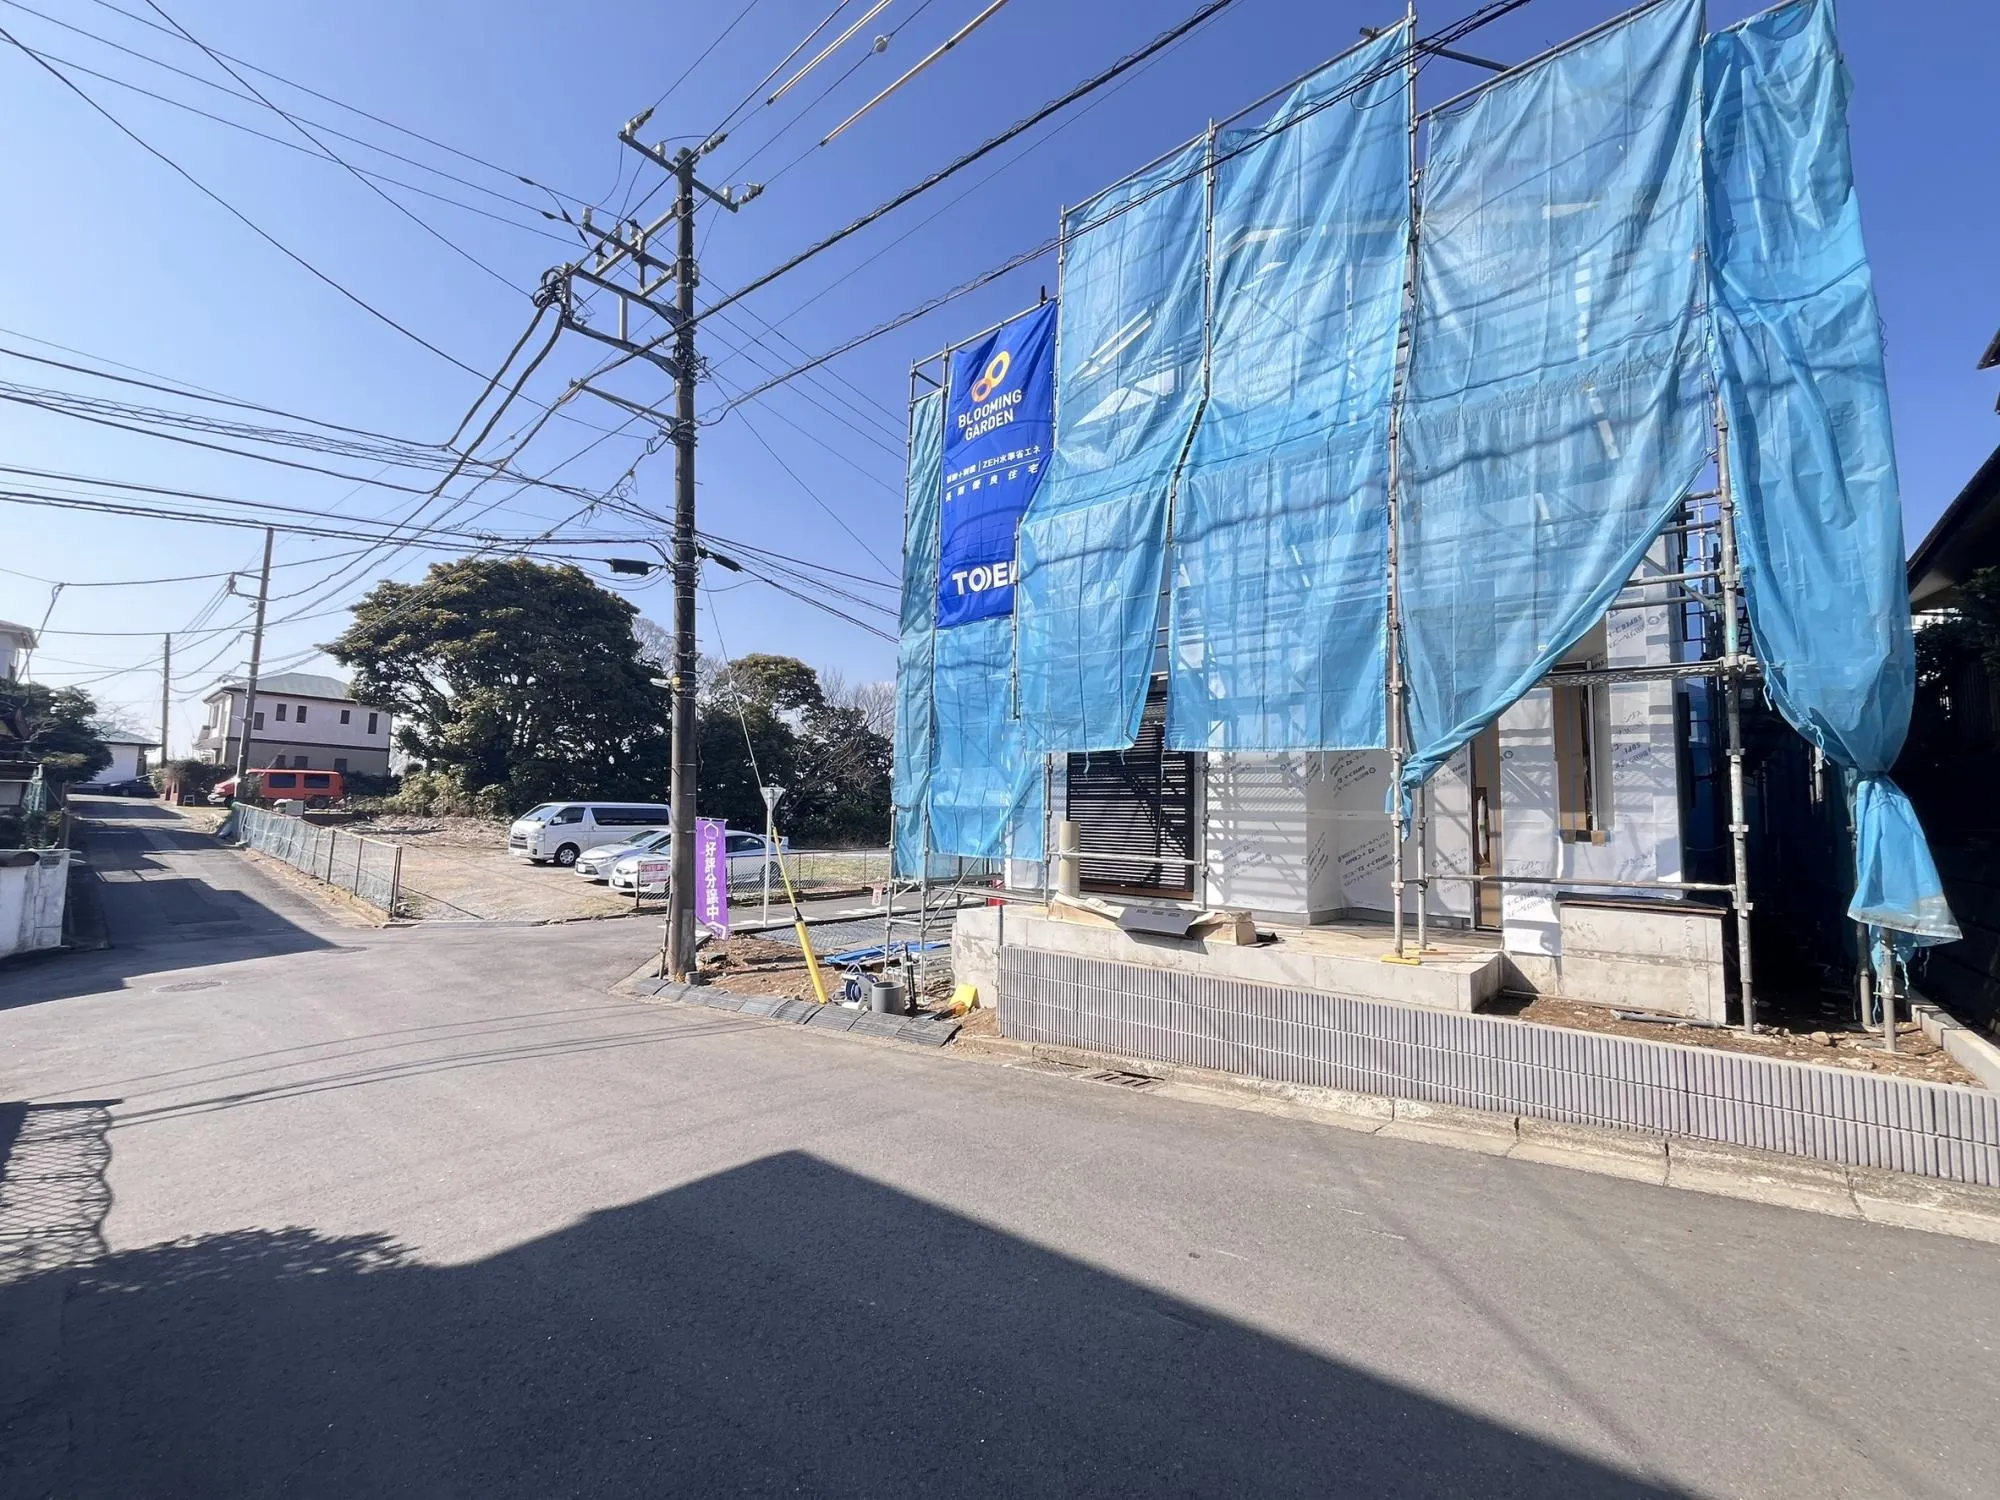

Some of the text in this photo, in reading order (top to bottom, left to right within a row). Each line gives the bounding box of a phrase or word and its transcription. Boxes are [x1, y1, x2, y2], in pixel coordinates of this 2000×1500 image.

[958, 388, 1022, 428] BLOOMING
[965, 407, 1014, 441] GARDEN
[704, 841, 719, 921] 好評分譲中
